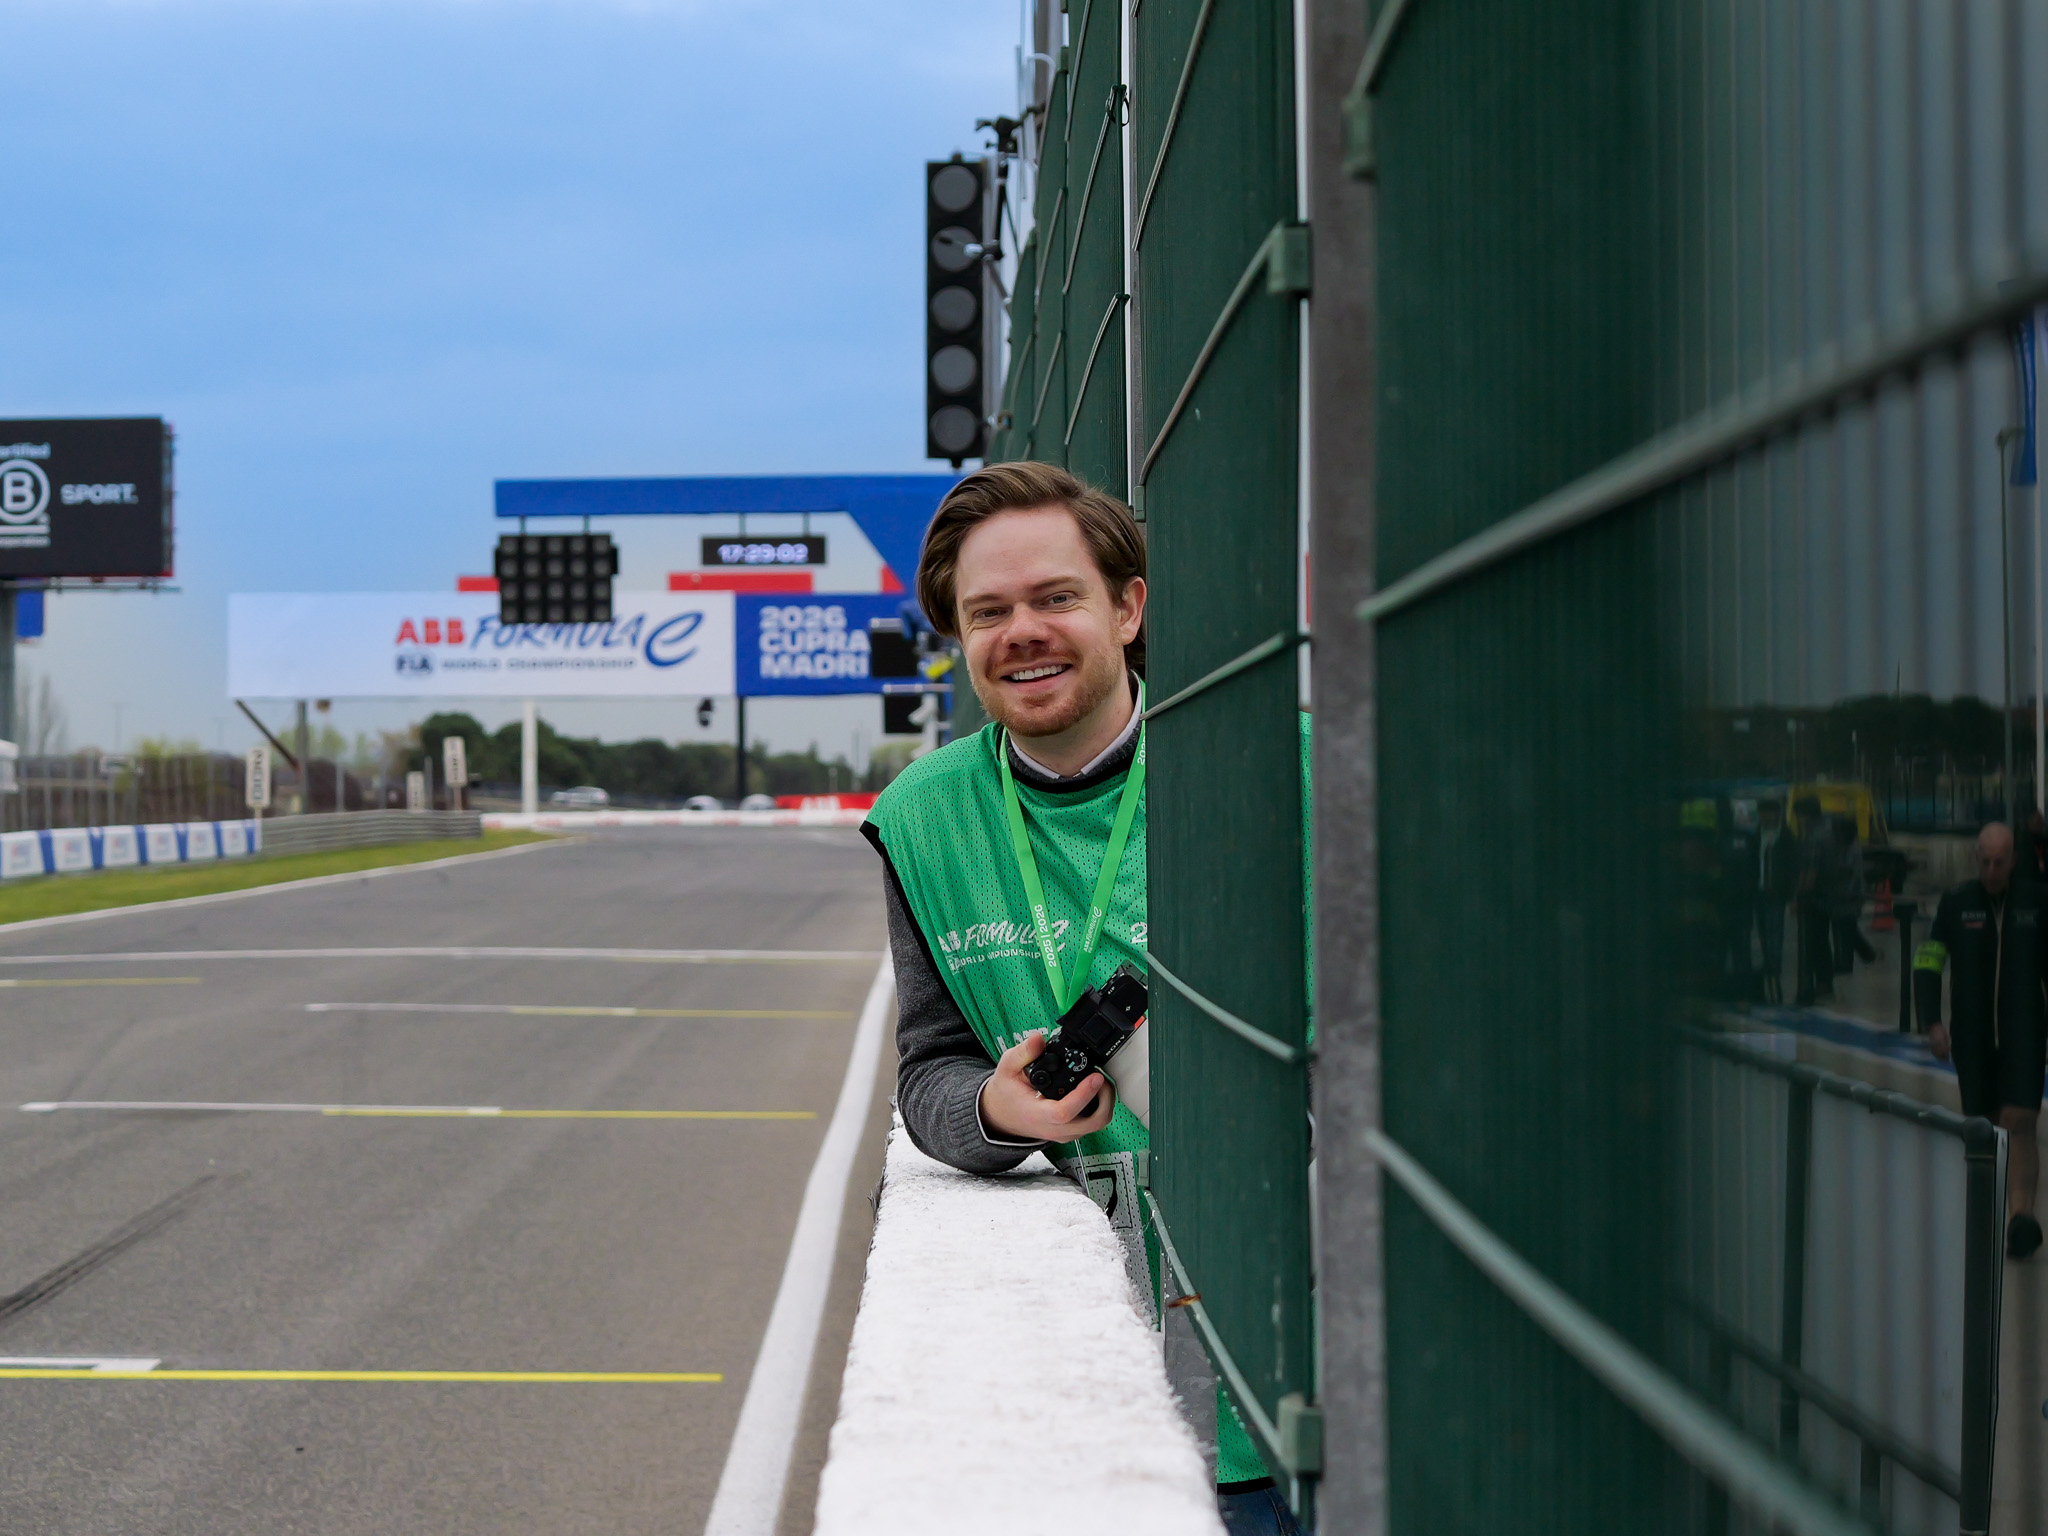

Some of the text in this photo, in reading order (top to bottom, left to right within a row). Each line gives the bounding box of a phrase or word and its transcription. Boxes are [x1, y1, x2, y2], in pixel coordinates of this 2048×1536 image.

[759, 605, 847, 630] 2026
[397, 618, 465, 645] ABB
[759, 629, 870, 654] CUPRA
[759, 654, 869, 679] MADRI
[1034, 904, 1049, 933] 2026
[1042, 939, 1057, 968] 2025
